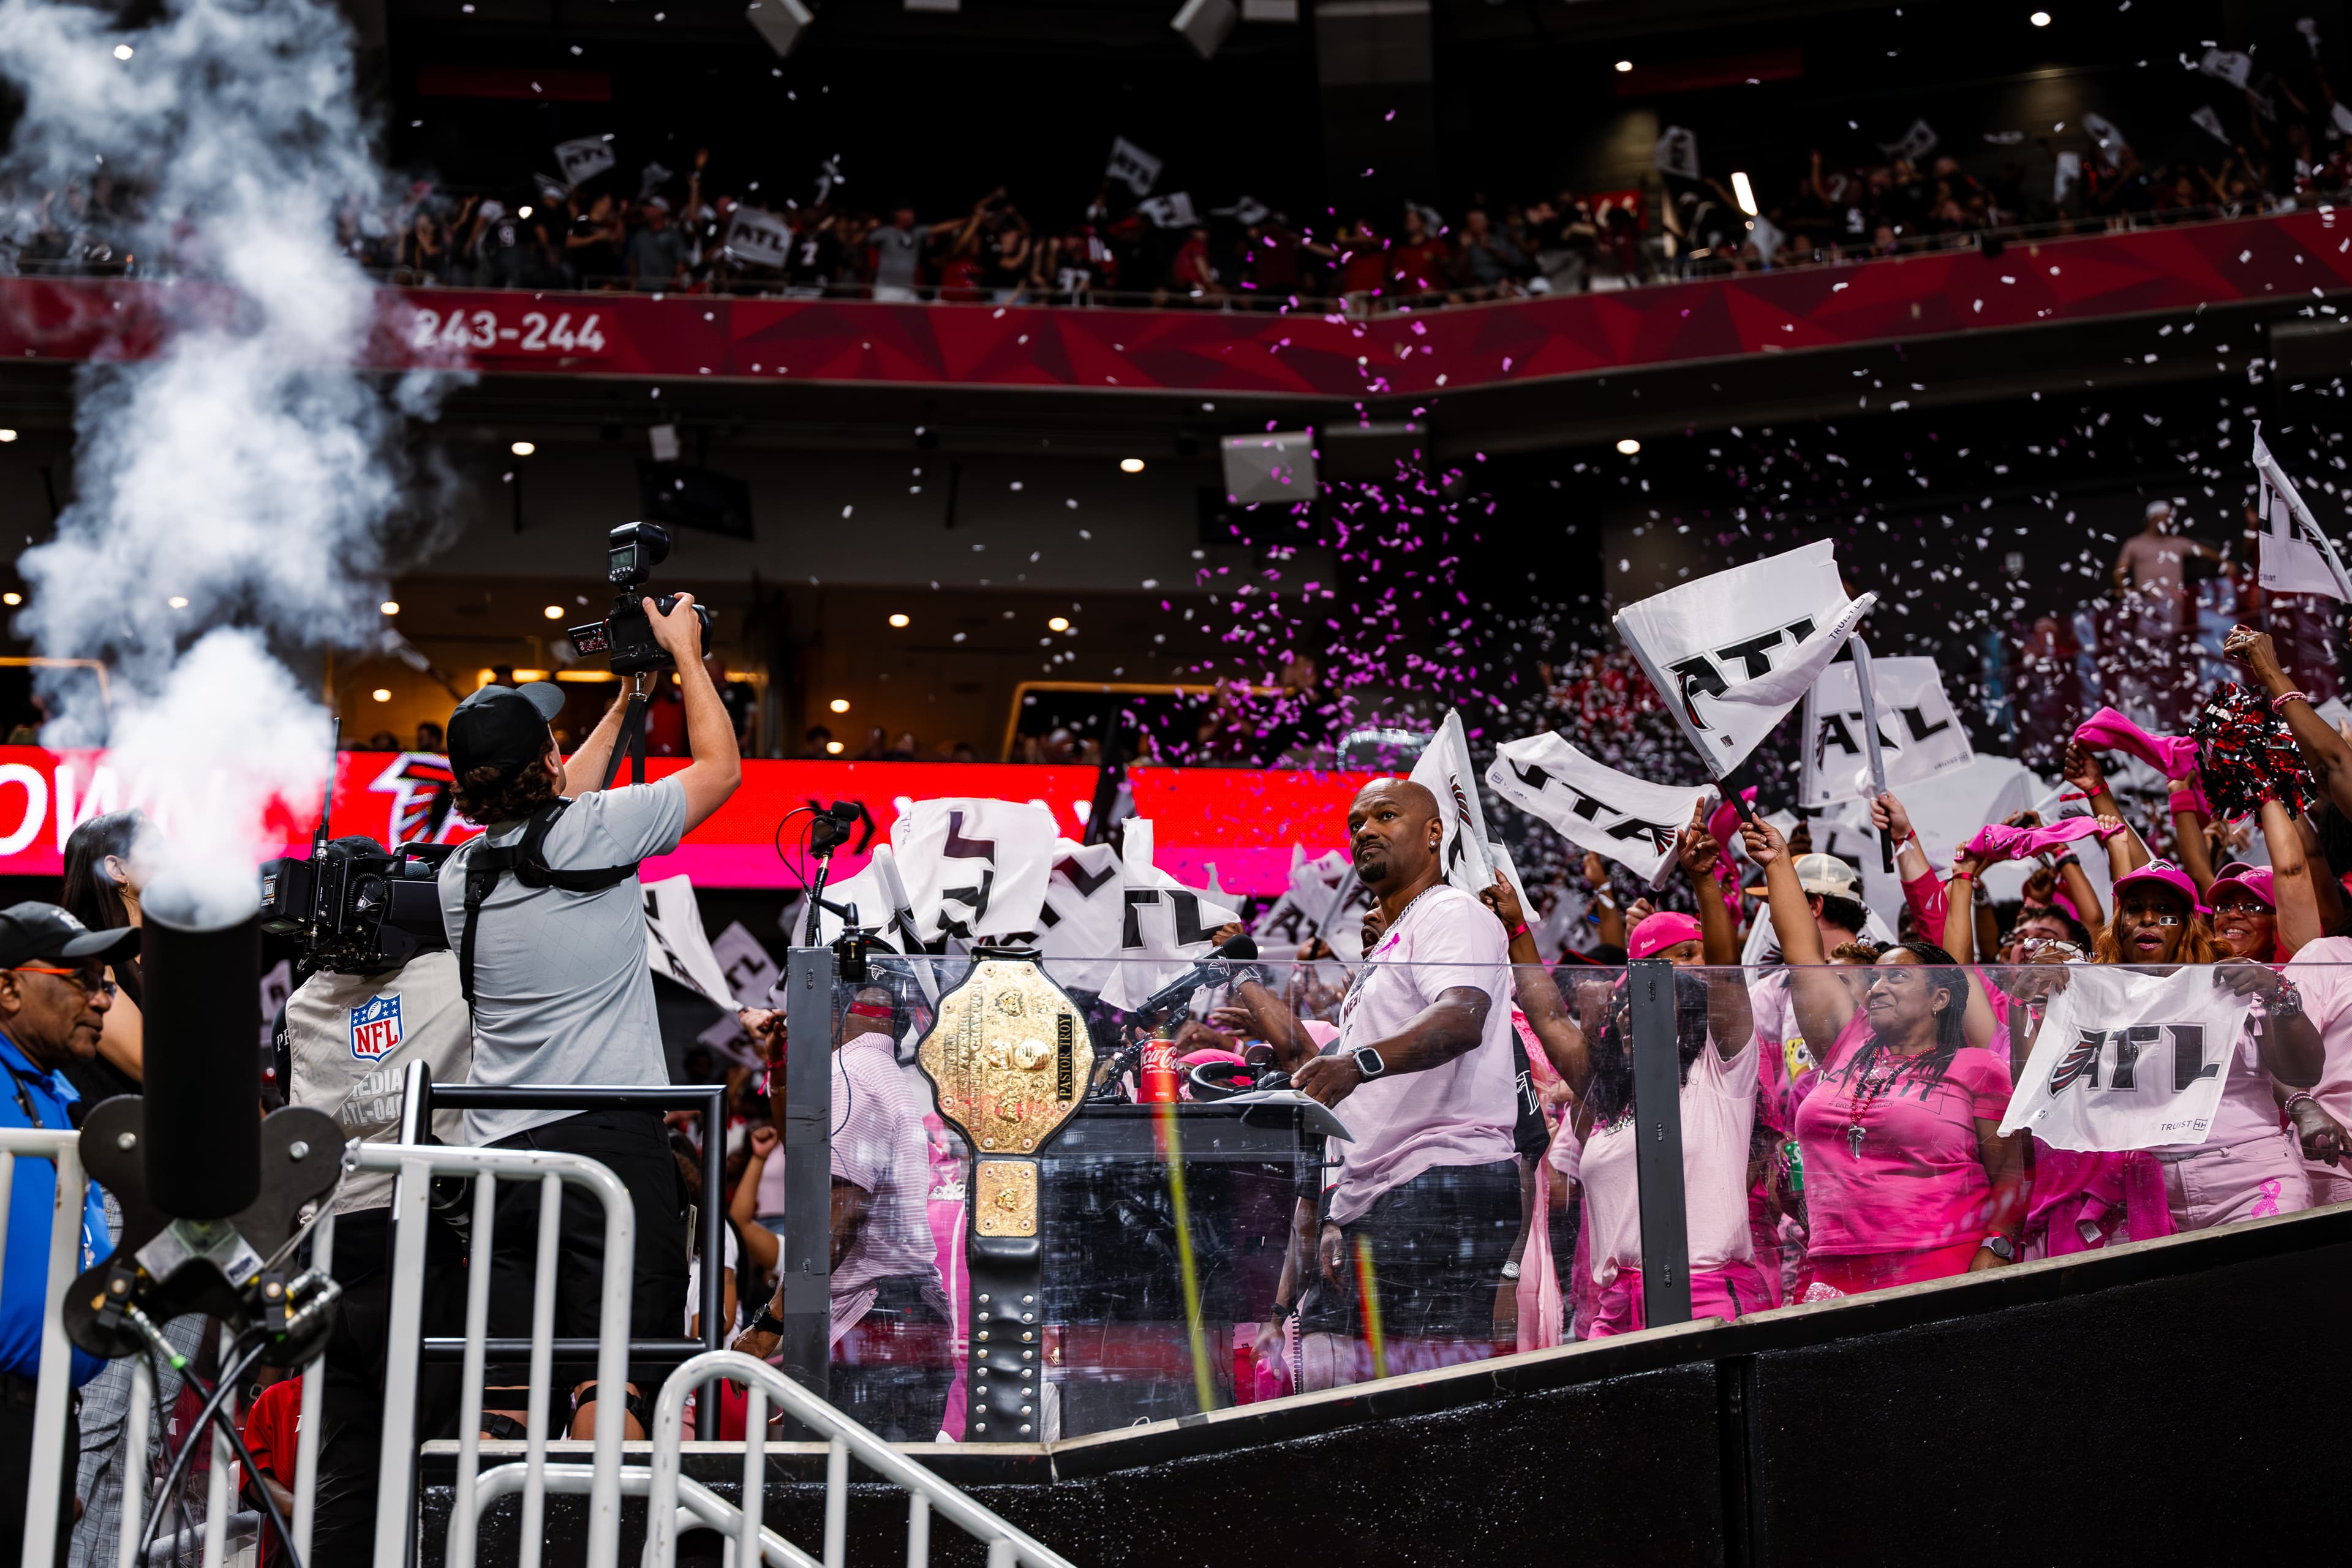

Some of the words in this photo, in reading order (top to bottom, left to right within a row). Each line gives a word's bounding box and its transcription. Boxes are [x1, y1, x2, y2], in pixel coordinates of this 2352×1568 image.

[413, 309, 606, 352] 243-244
[355, 1019, 399, 1054] NFL
[1059, 1017, 1071, 1046] TROY
[1059, 1053, 1071, 1096] PASTOR
[2048, 1020, 2224, 1099] ATL
[2161, 1120, 2193, 1132] TRUIST
